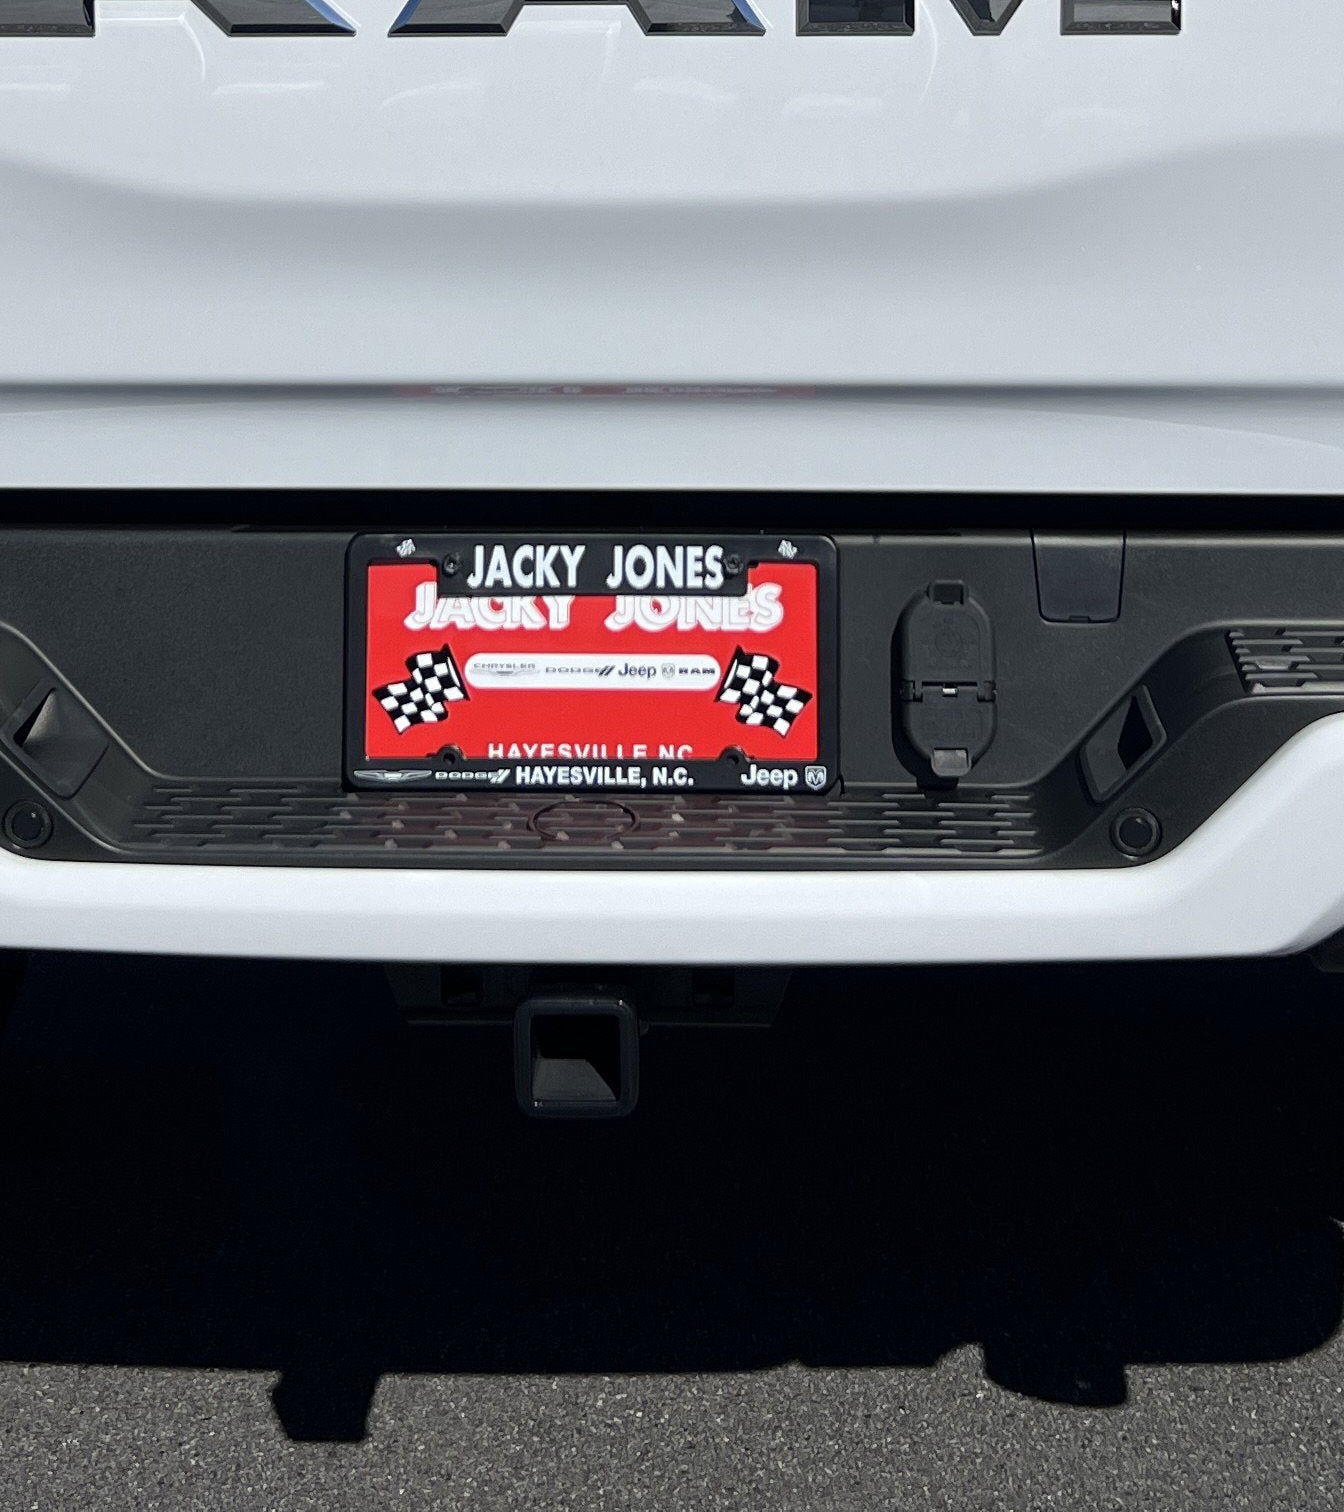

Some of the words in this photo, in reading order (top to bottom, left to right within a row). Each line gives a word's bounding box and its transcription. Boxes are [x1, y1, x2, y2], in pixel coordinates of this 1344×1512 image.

[466, 544, 586, 589] JACKY
[606, 544, 725, 589] JONES
[403, 581, 575, 631] JACKY
[603, 581, 785, 633] JONES
[473, 662, 536, 670] CHRYSLER
[618, 662, 657, 679] Jeep
[678, 667, 716, 675] RAM
[516, 766, 647, 788] HAYESVILLE,
[652, 766, 694, 787] N.C.
[740, 764, 799, 790] Jeep
